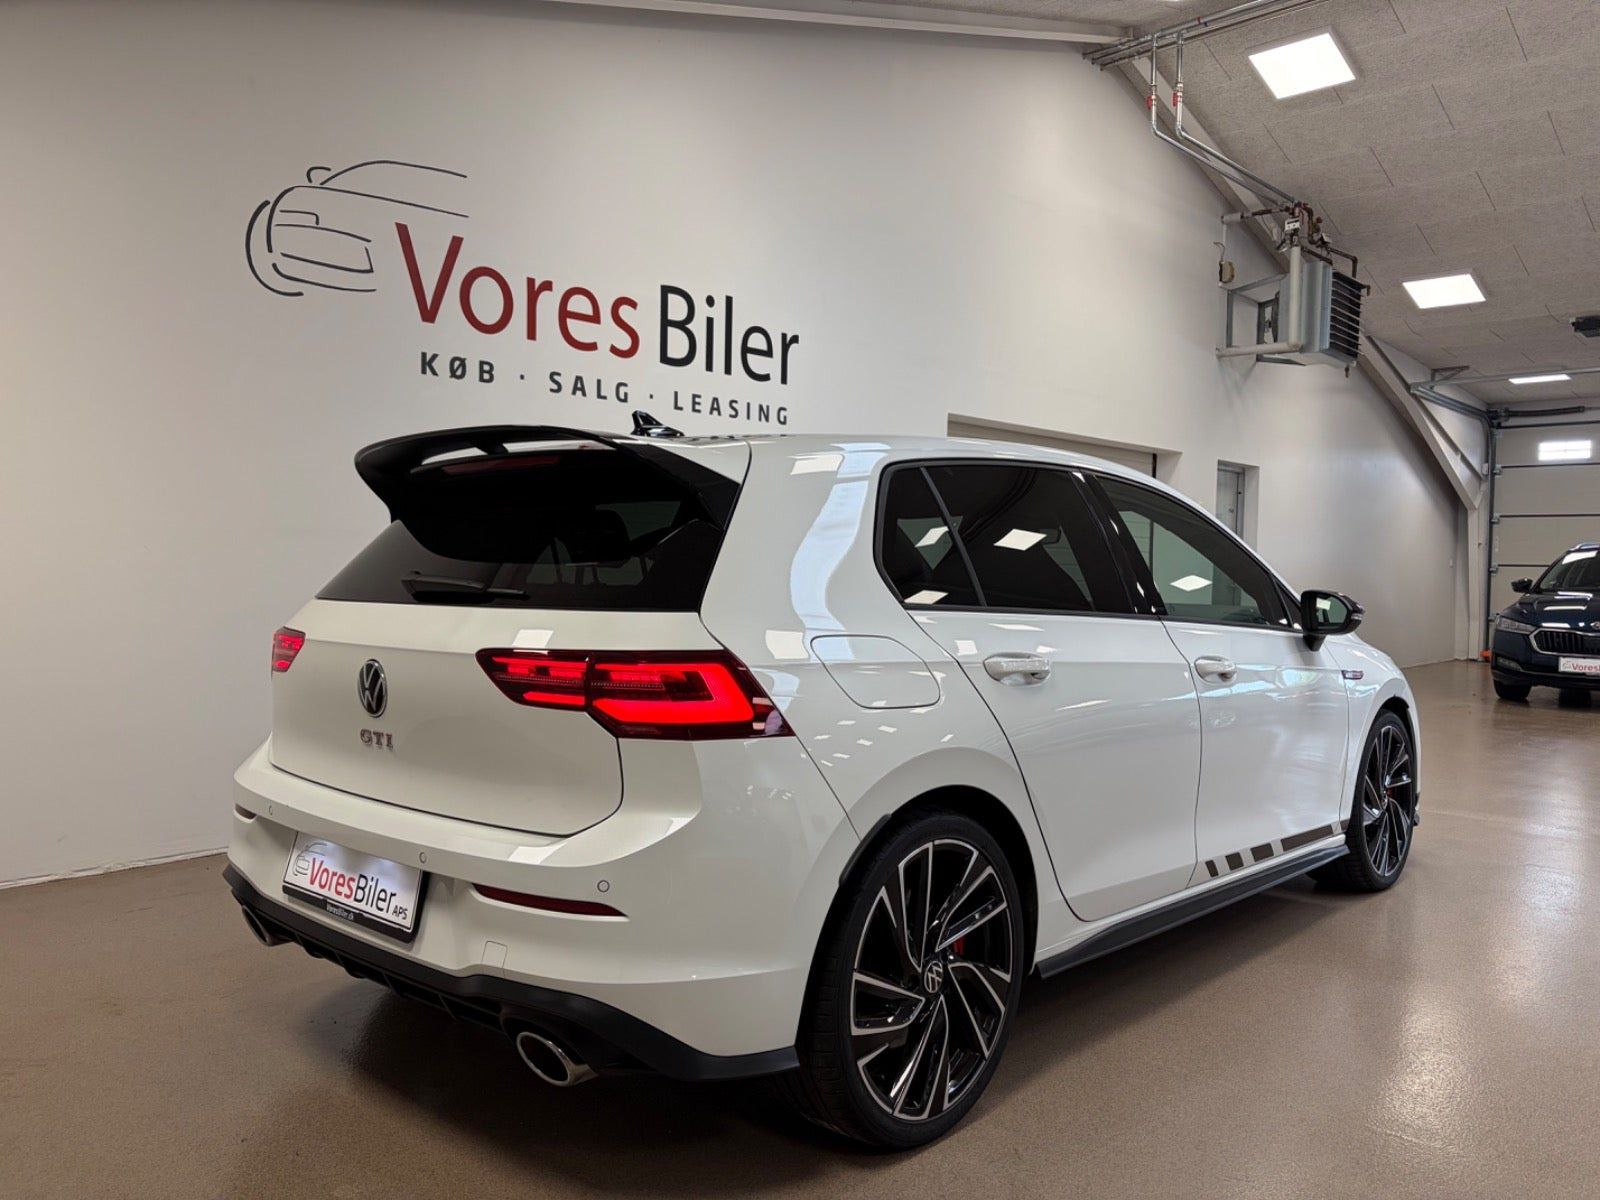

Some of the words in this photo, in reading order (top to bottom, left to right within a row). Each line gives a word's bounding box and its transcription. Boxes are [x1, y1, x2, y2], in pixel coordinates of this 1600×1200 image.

[420, 352, 496, 384] KØB
[548, 371, 630, 404] SALG
[672, 391, 789, 426] LEASING
[360, 728, 394, 750] GTI
[392, 904, 408, 920] APS
